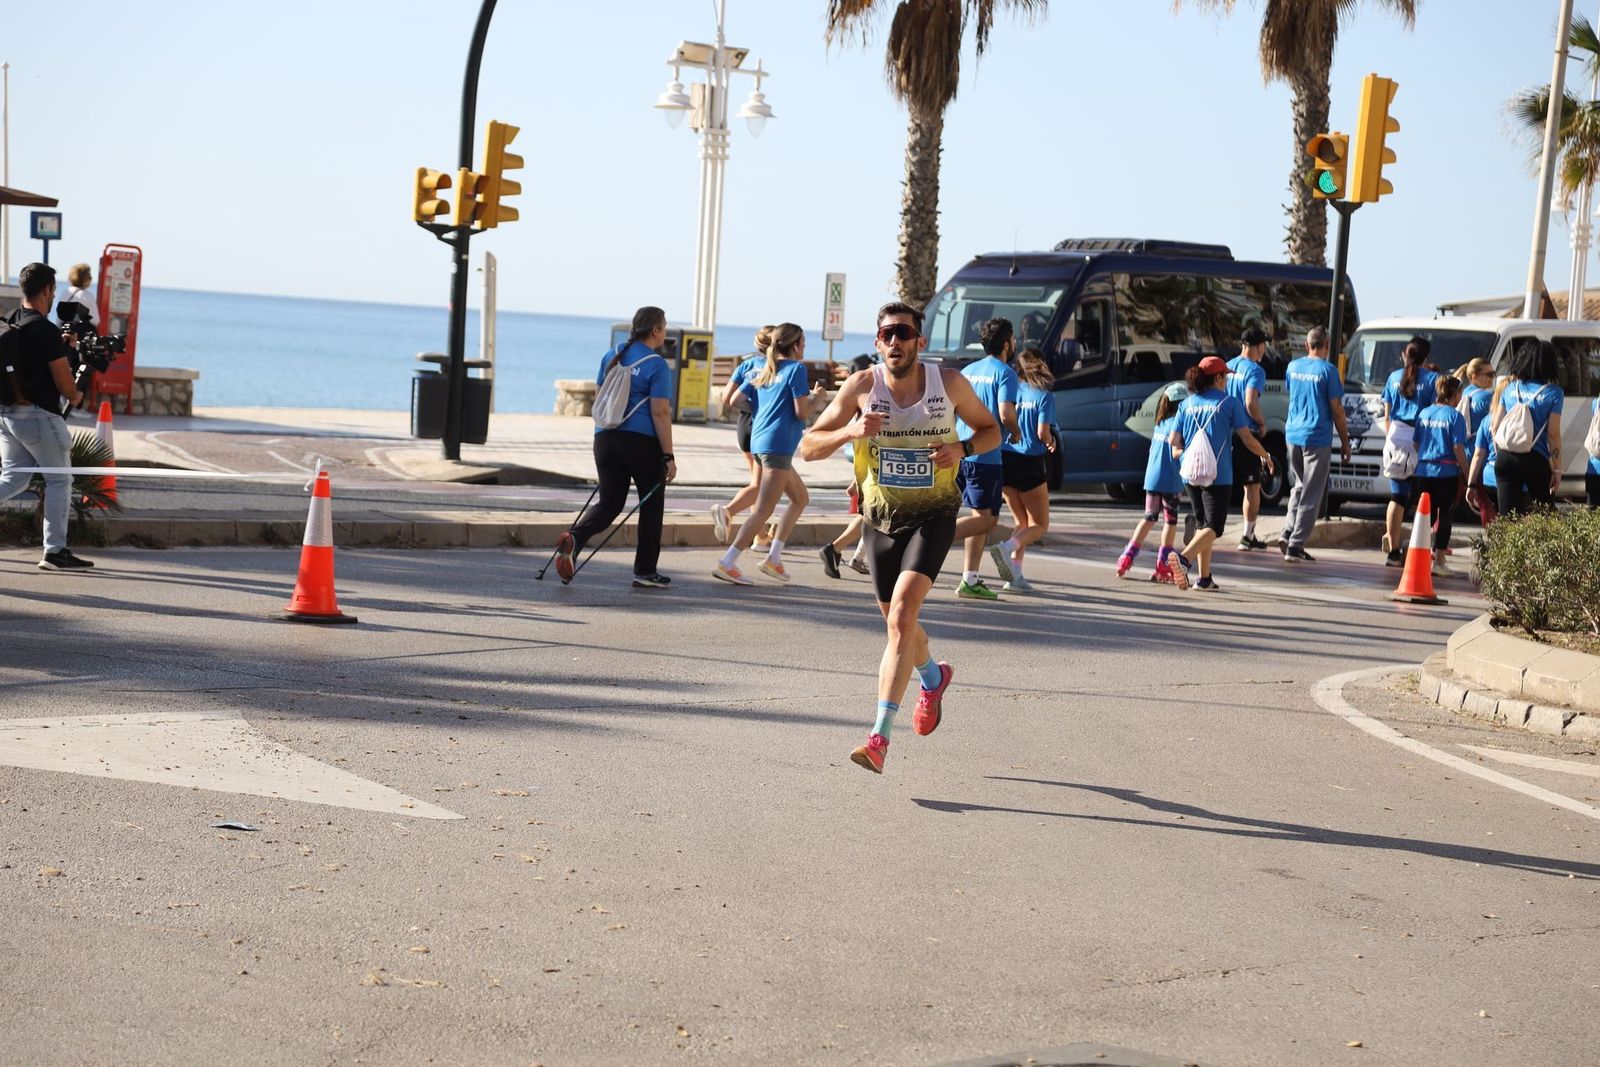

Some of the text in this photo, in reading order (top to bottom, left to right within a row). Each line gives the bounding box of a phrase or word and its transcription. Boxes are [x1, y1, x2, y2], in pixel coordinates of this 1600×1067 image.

[829, 312, 840, 324] 31
[1290, 372, 1323, 383] mayoral
[882, 427, 921, 438] TRIATLÓN
[886, 462, 928, 475] 1950
